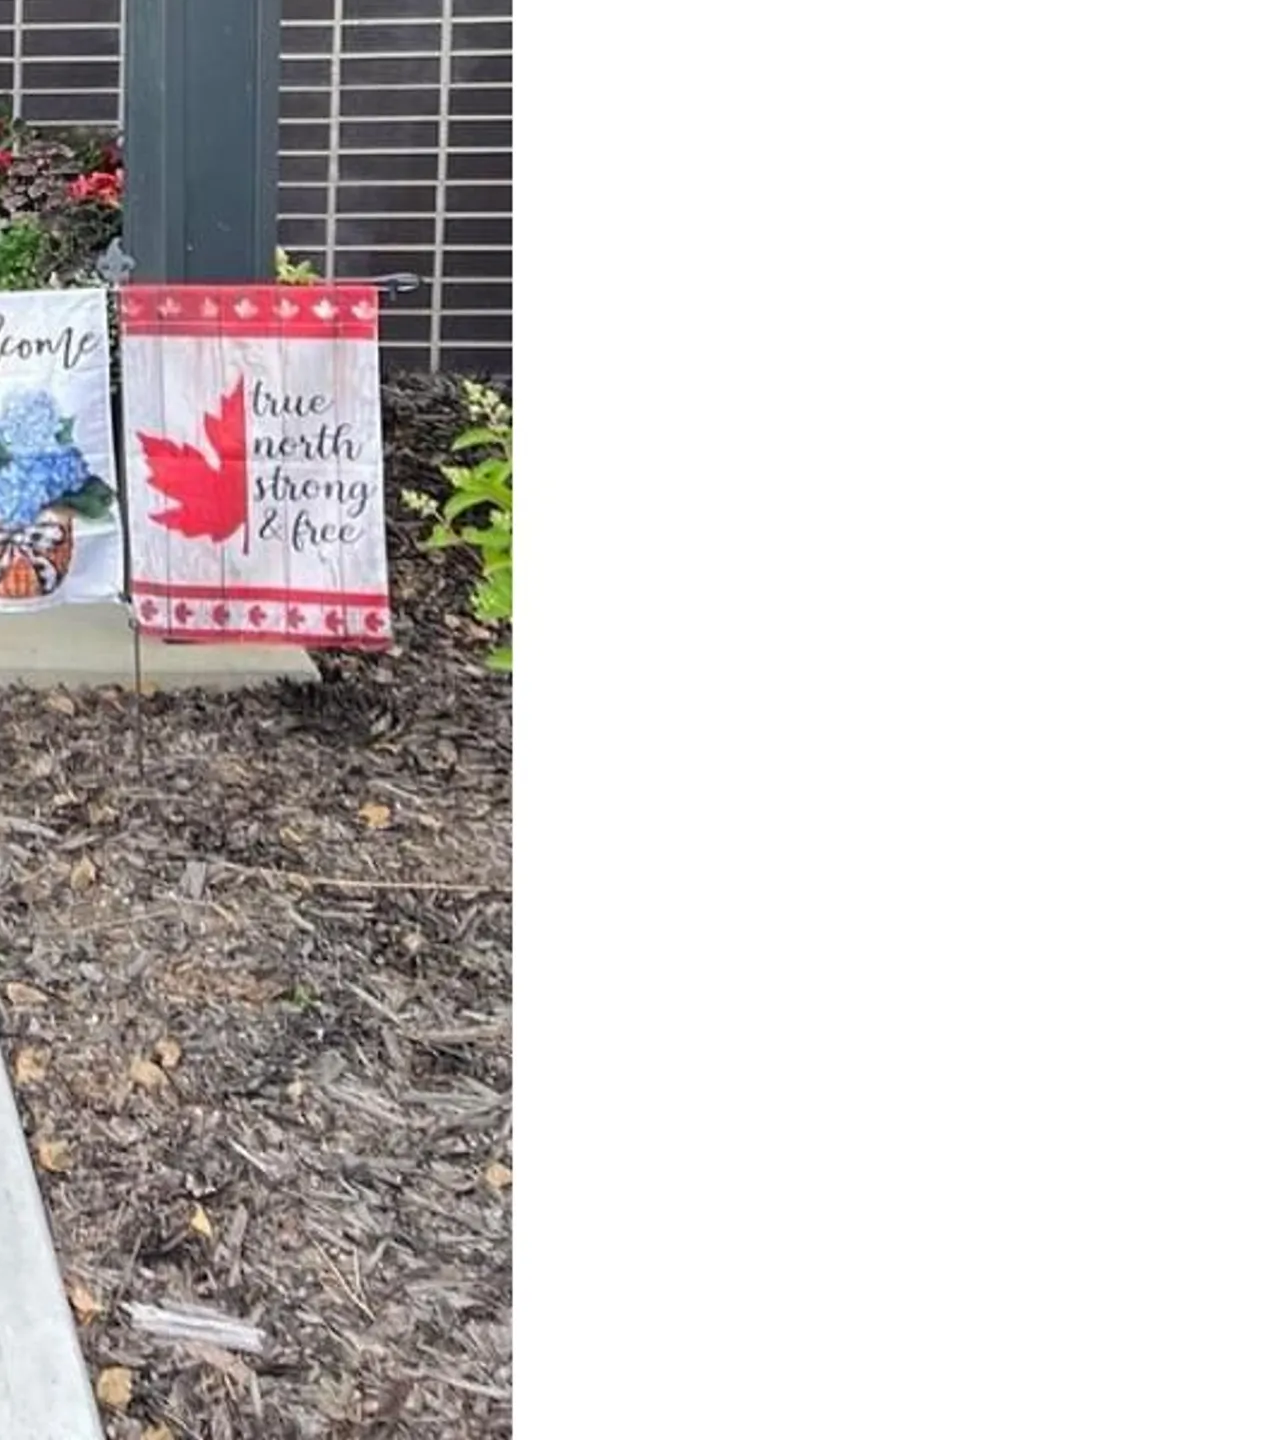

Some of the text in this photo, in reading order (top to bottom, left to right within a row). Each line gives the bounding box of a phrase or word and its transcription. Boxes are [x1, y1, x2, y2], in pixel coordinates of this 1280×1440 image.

[253, 379, 333, 417] true
[253, 423, 361, 461] north
[253, 466, 377, 519] strong
[259, 509, 363, 552] & free
